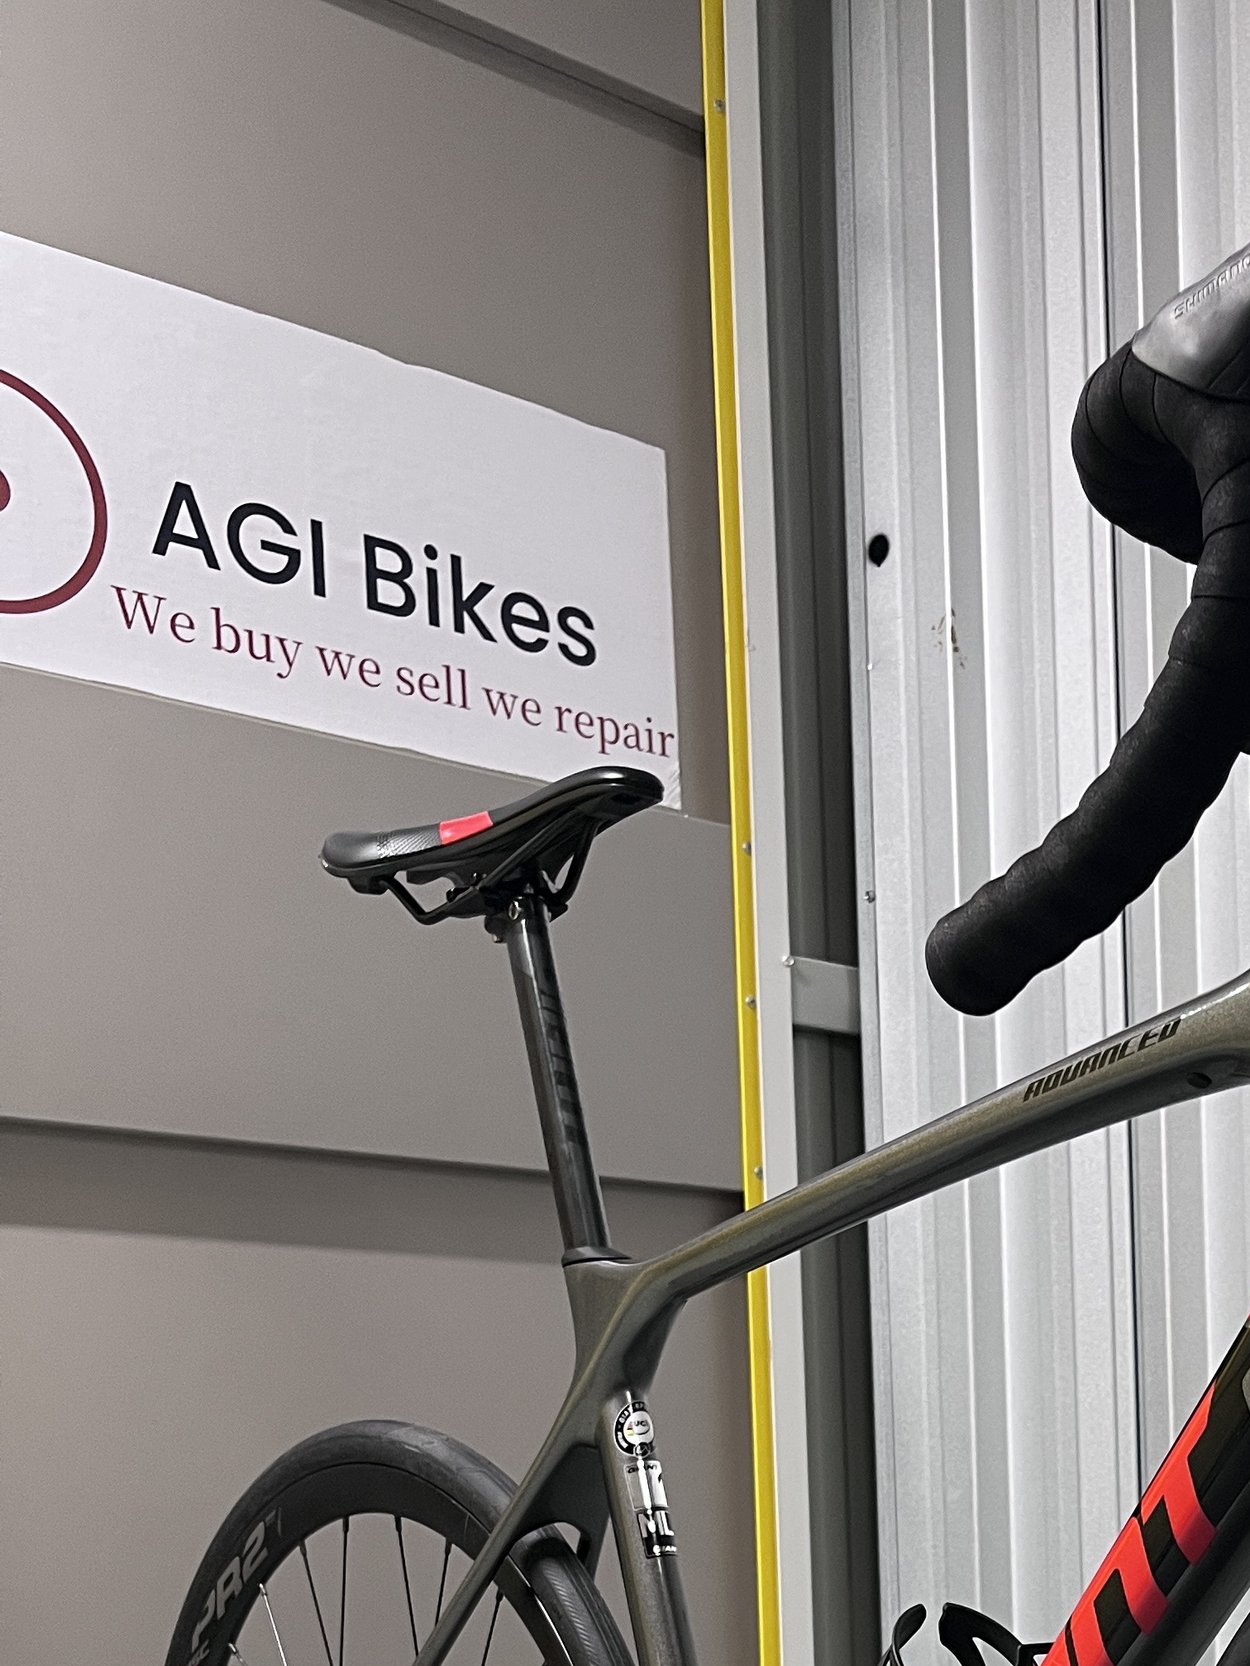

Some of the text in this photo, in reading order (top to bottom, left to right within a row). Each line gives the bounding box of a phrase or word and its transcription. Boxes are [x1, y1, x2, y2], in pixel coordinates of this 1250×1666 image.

[152, 481, 599, 668] AGI Bikes
[110, 585, 676, 758] We buy we sell we repair
